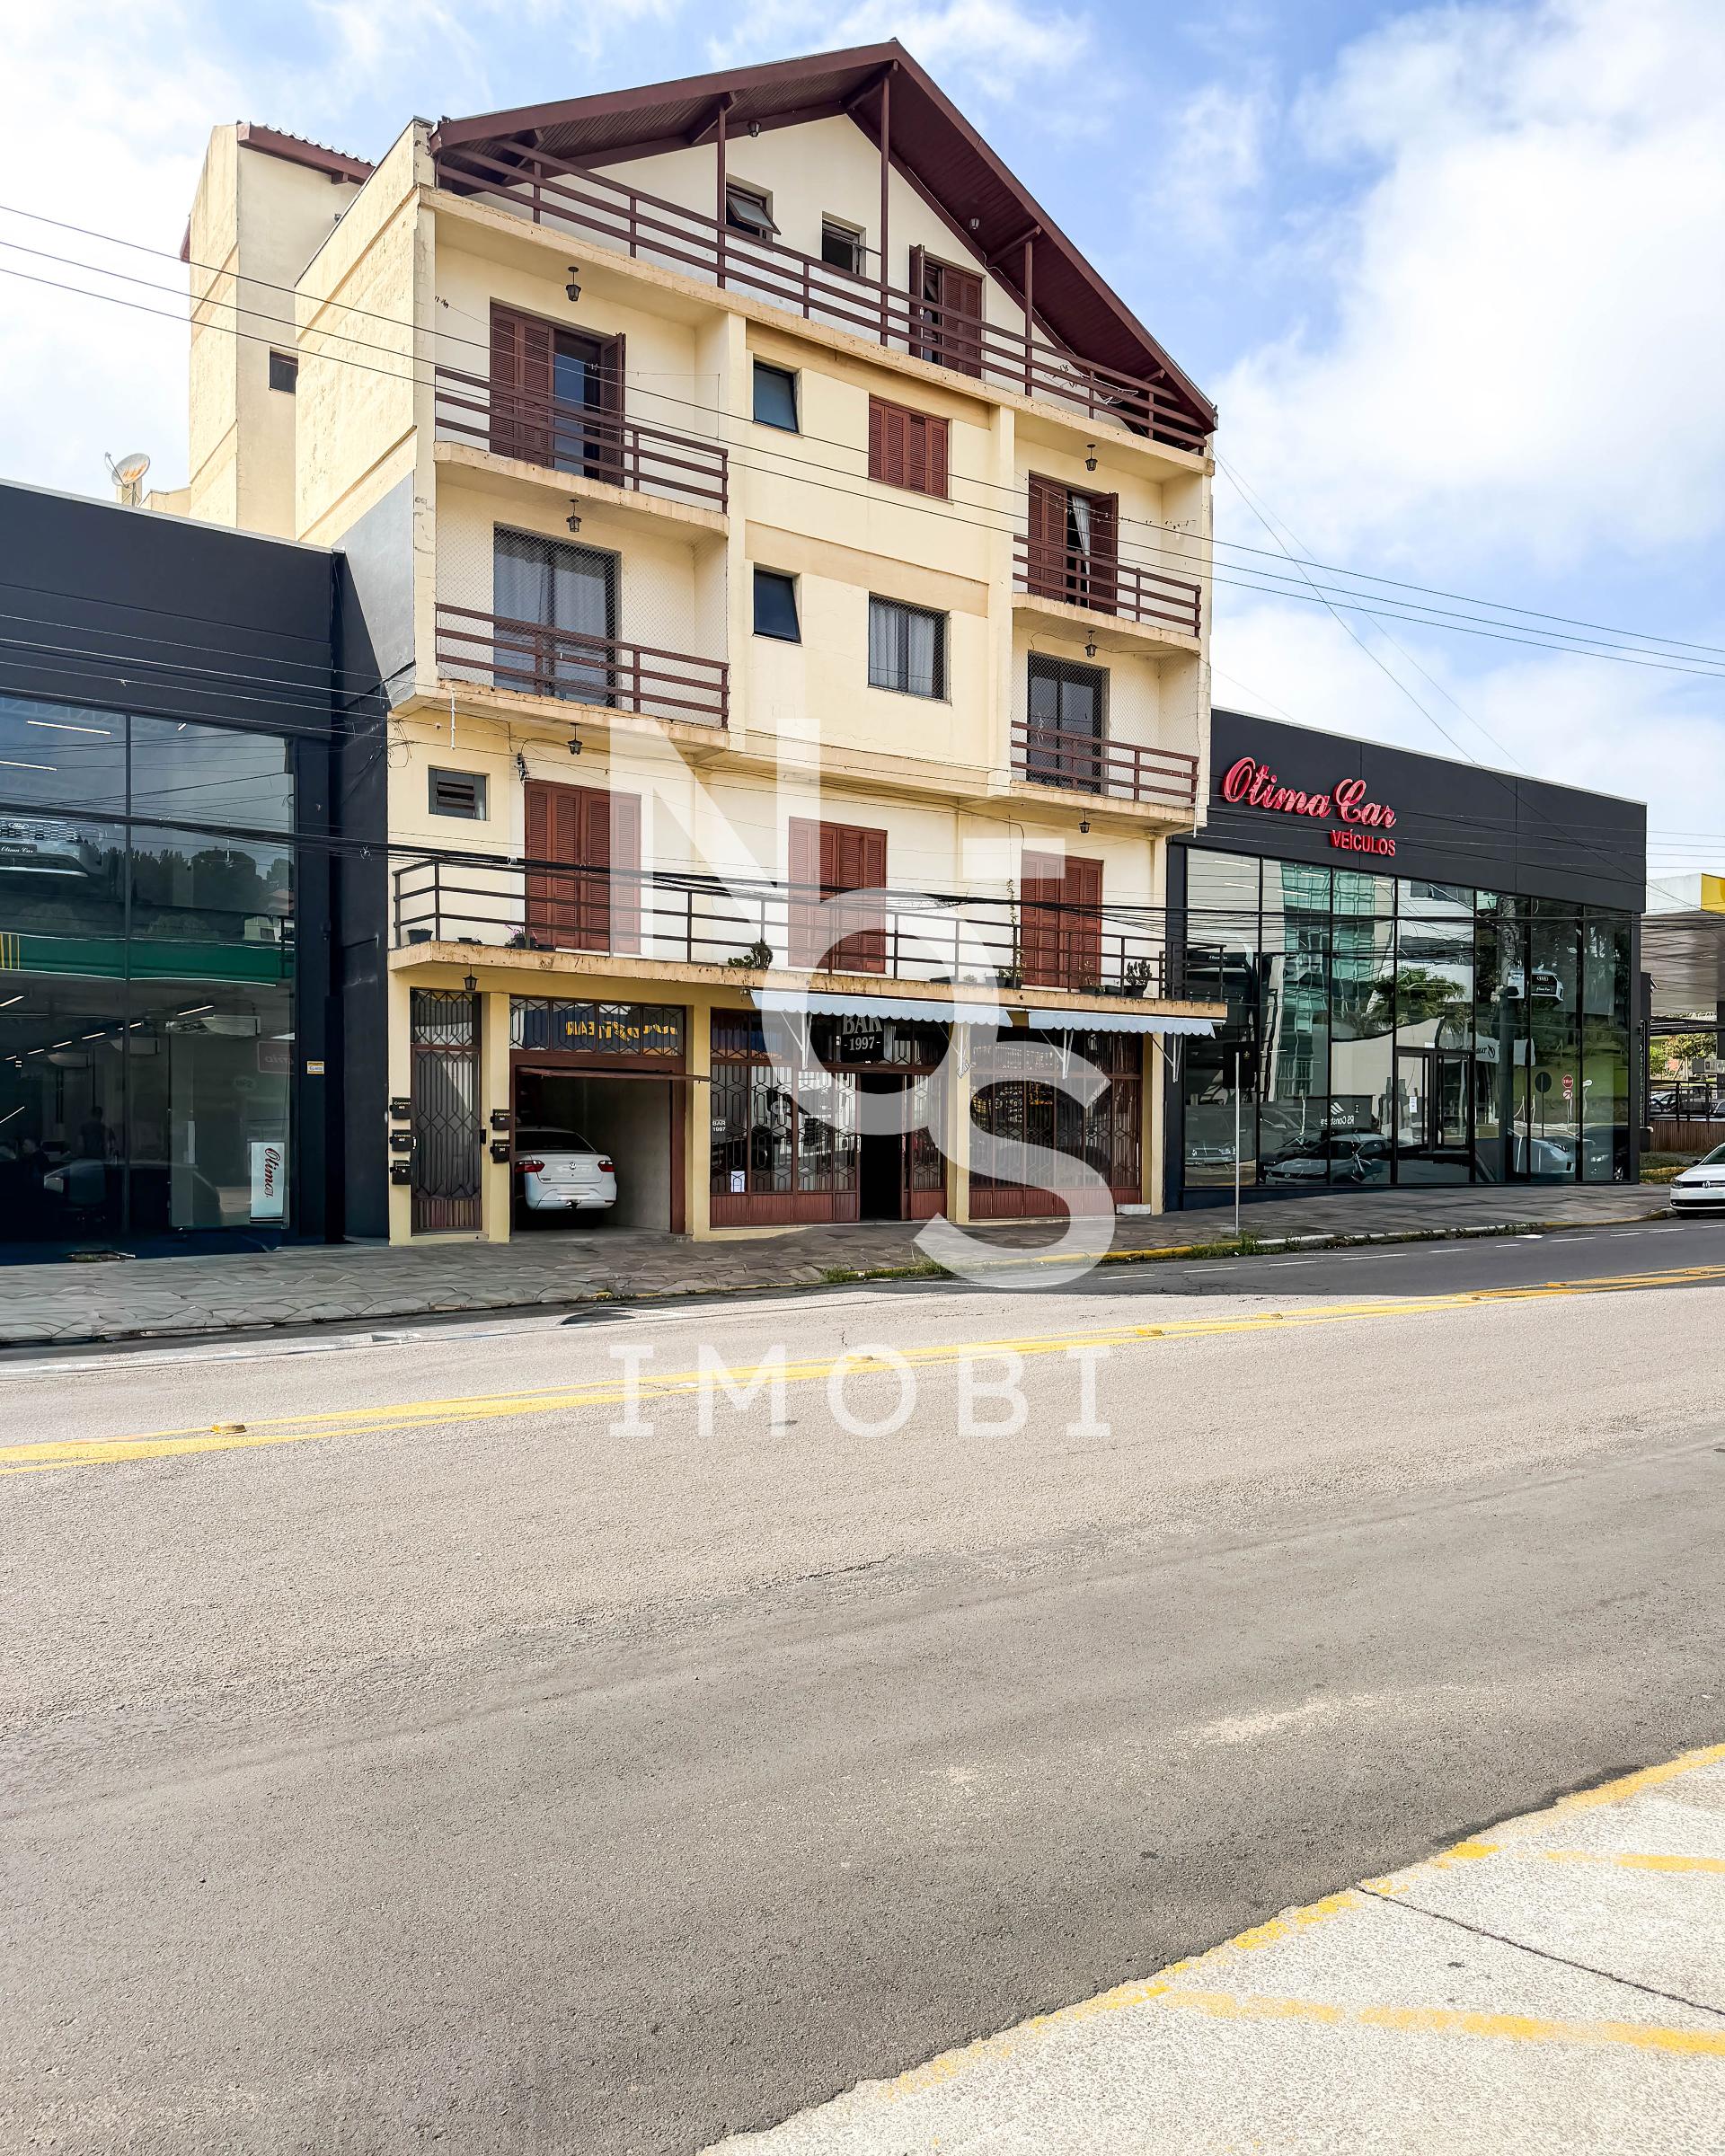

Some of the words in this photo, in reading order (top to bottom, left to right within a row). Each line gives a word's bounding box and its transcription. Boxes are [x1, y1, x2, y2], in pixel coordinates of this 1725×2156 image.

[1223, 756, 1331, 818] Otima
[1332, 778, 1397, 829] Car
[1330, 828, 1396, 857] VEÍCULOS
